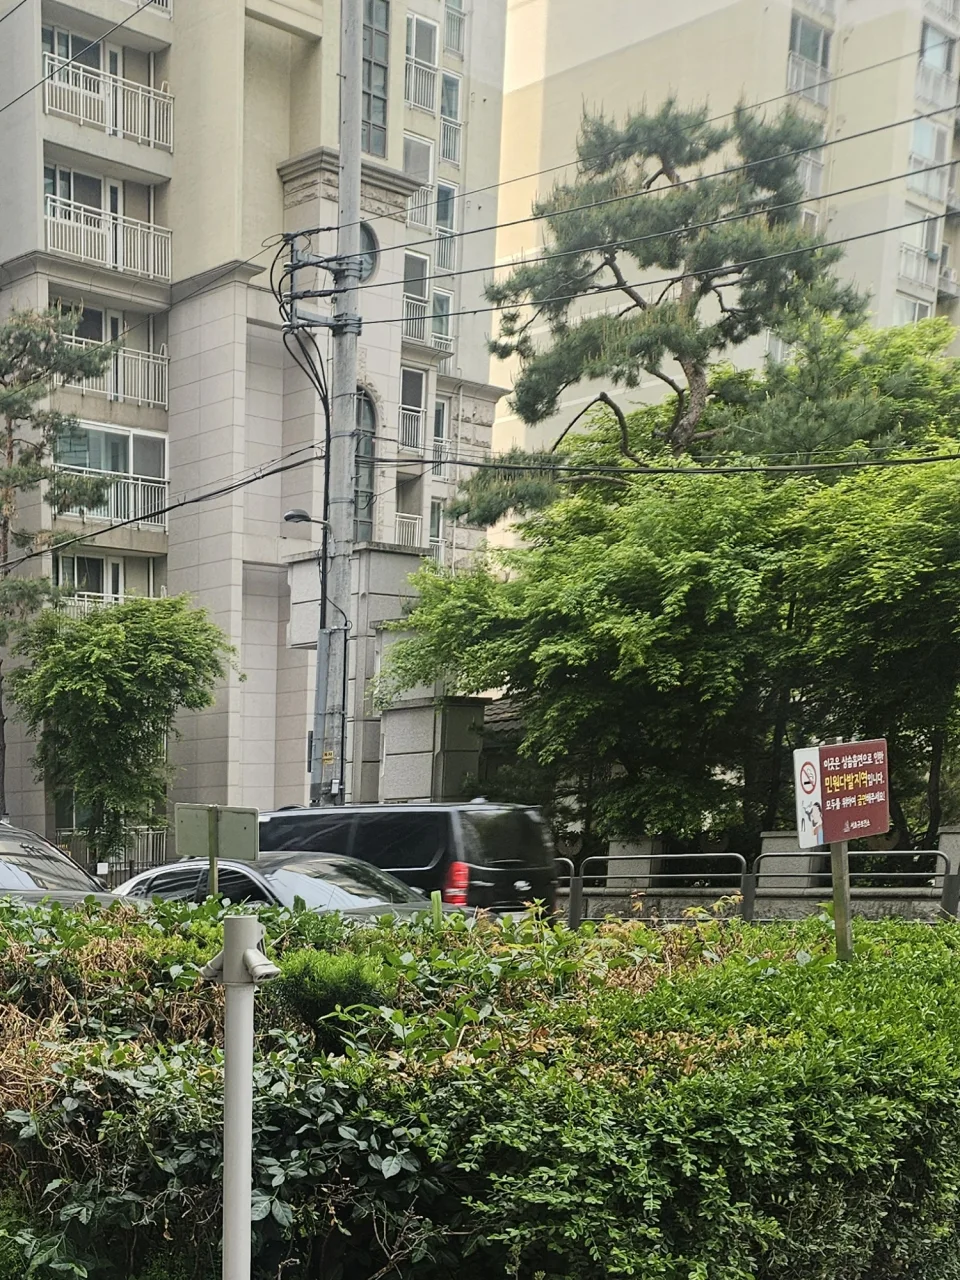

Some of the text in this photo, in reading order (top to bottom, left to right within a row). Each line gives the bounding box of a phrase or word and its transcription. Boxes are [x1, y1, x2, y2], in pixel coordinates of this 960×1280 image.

[823, 756, 841, 771] 이곳은
[873, 751, 885, 765] 인한
[824, 770, 886, 794] 민원다발지역입니다.
